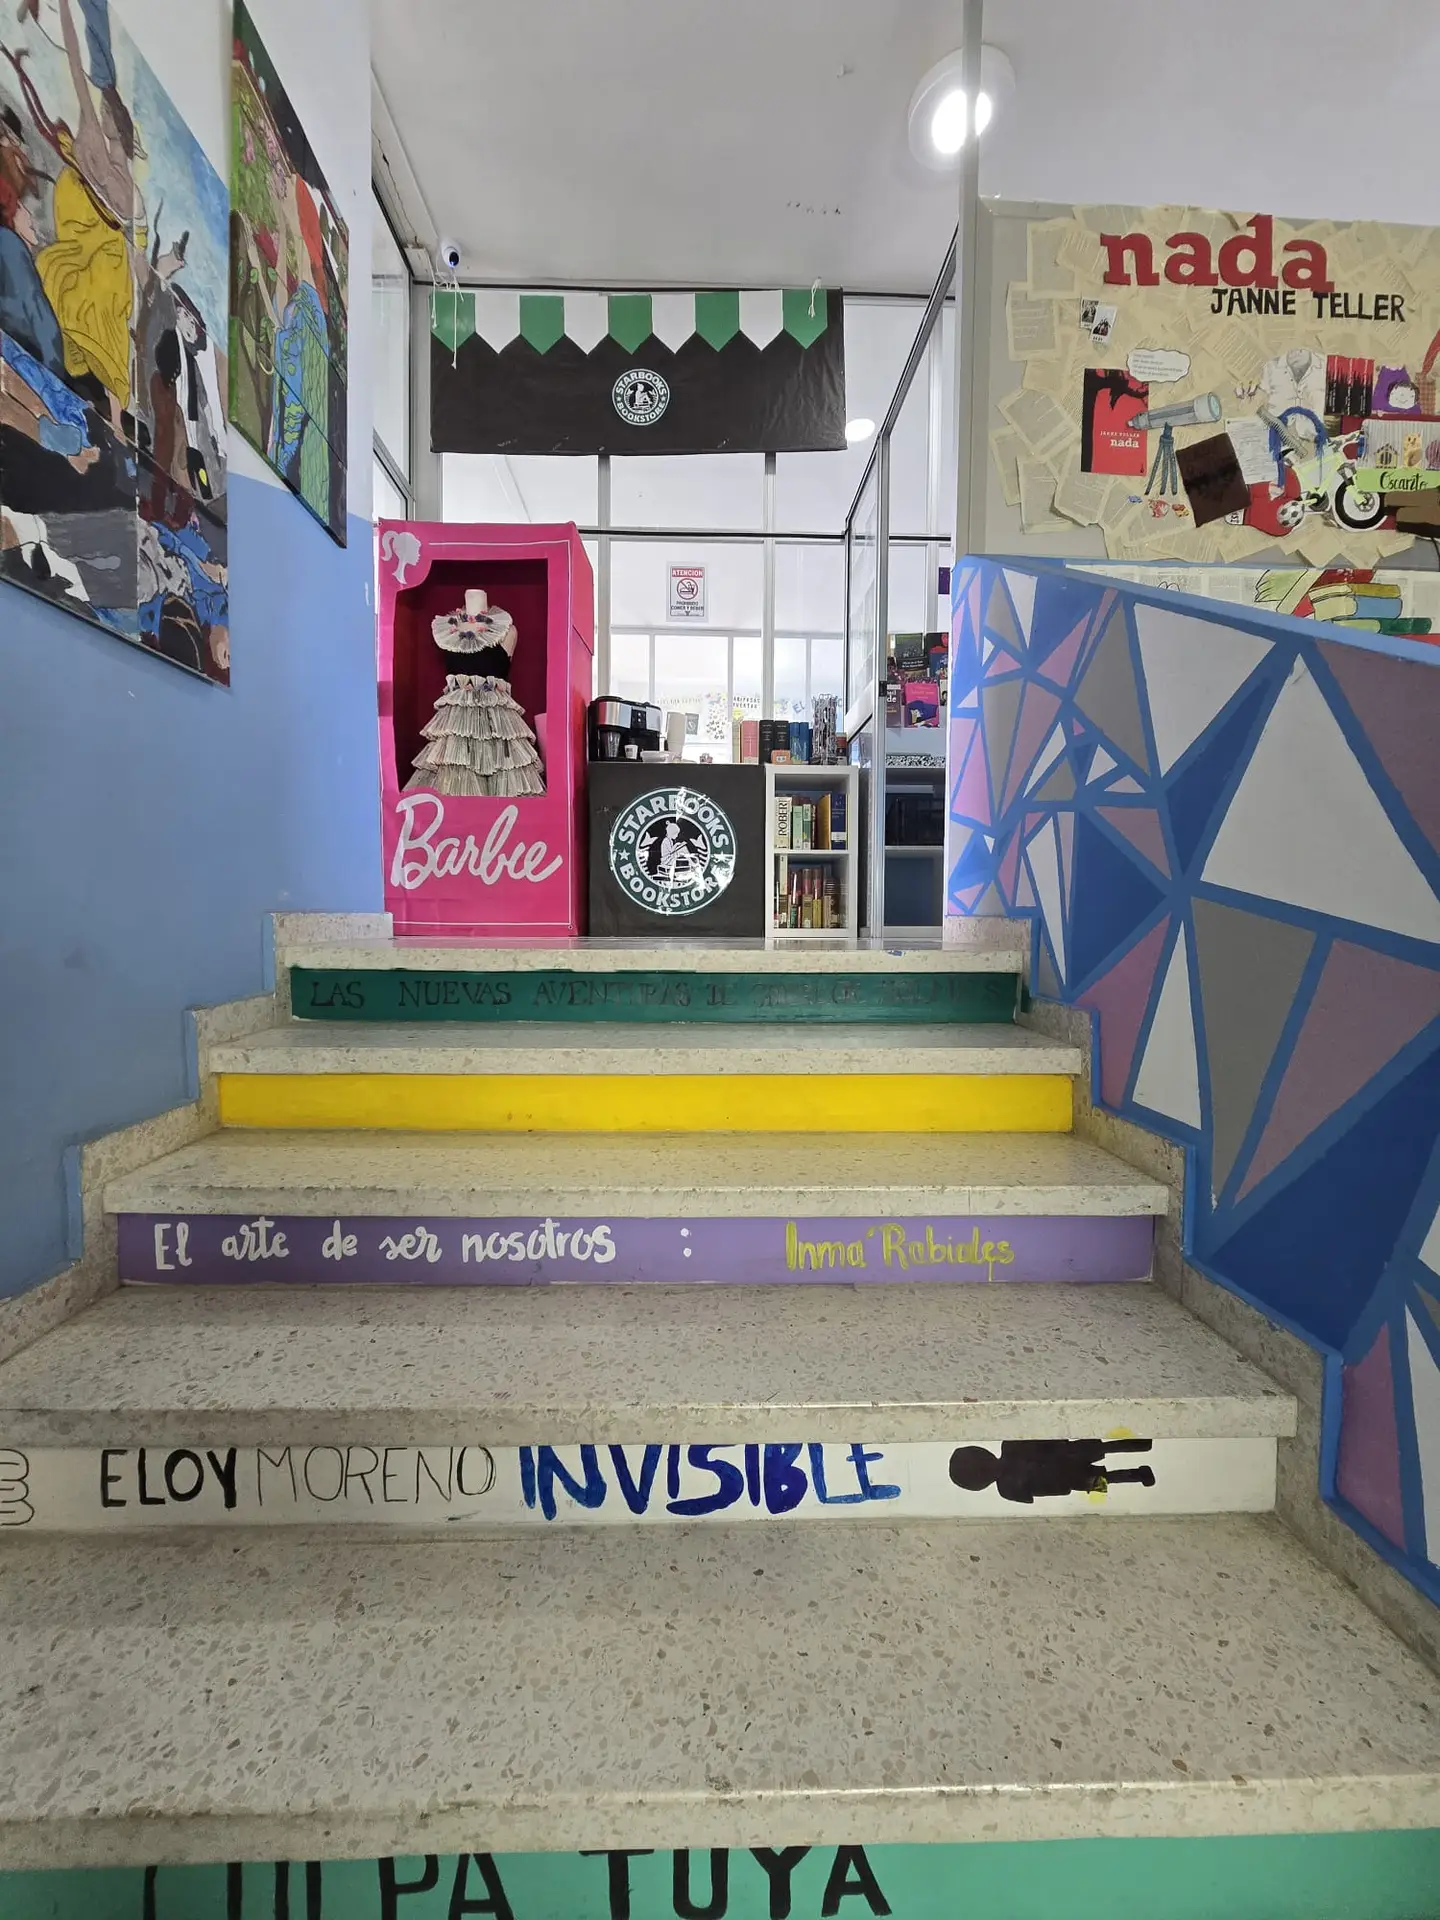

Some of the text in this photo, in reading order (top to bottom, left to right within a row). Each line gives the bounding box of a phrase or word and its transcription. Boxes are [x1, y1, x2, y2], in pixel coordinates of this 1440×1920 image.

[1100, 214, 1335, 292] nada
[1210, 288, 1406, 322] JANNE TELLER
[615, 371, 667, 395] STARBOOKS
[616, 402, 666, 423] BOOKSTORE
[1110, 438, 1139, 448] nada
[391, 793, 563, 889] Barbie
[618, 794, 729, 849] STARBOOKS
[619, 862, 724, 908] BOOKSTOR
[310, 981, 365, 1009] LAS
[398, 980, 512, 1008] NUEVAS
[154, 1222, 193, 1270] El
[221, 1216, 290, 1262] arte
[322, 1219, 358, 1260] de
[379, 1226, 443, 1263] ser
[462, 1218, 616, 1264] nosotros
[101, 1443, 902, 1520] ELOY MORENO INVISIBLE
[578, 1844, 893, 1920] TUYA
